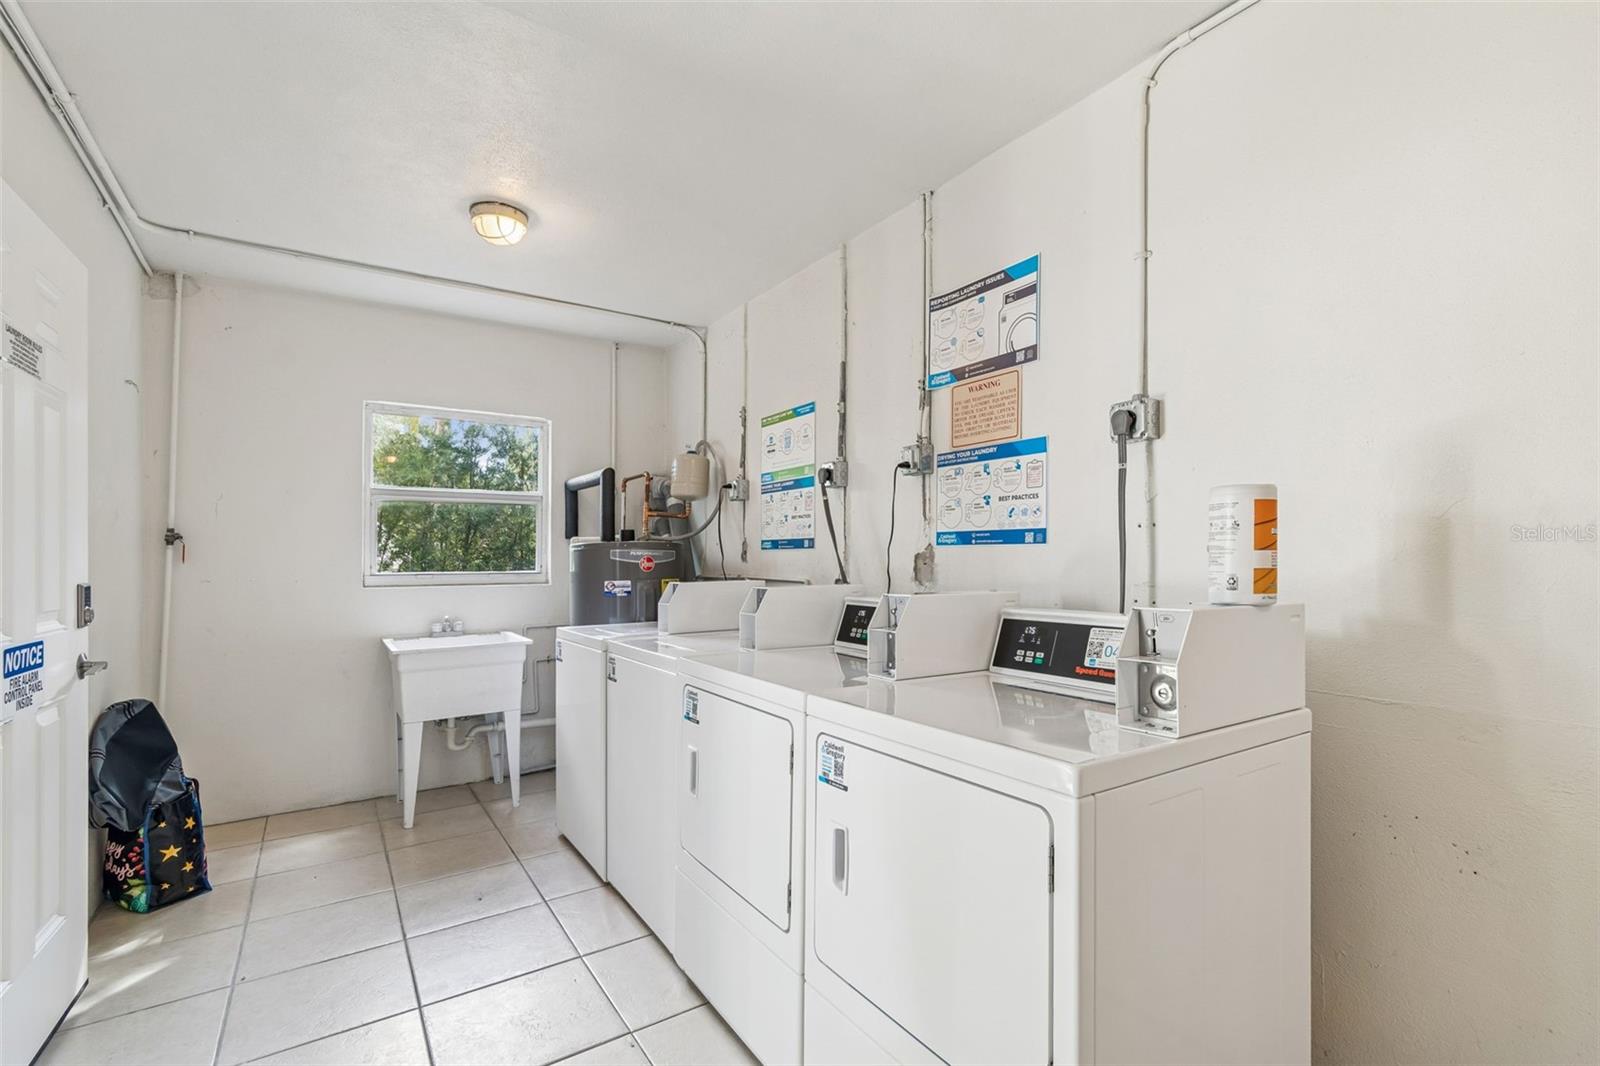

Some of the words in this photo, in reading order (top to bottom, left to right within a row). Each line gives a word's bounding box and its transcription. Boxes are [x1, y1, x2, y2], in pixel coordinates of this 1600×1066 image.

[930, 292, 959, 306] REPORTING
[960, 281, 984, 295] LAUNDRY
[985, 272, 1004, 285] ISSUES
[969, 380, 1000, 392] WARNING
[937, 453, 956, 461] DRYING
[956, 450, 970, 458] YOUR
[971, 446, 997, 456] LAUNDRY
[1011, 492, 1039, 500] PRACTICES
[5, 645, 43, 673] NOTICE
[1075, 666, 1098, 676] Speed
[10, 676, 21, 690] FIRE
[22, 670, 39, 684] ALARM
[4, 686, 28, 704] CONTROL
[28, 681, 43, 695] PANEL
[16, 694, 33, 711] INSIDE
[824, 741, 844, 753] Caldwell
